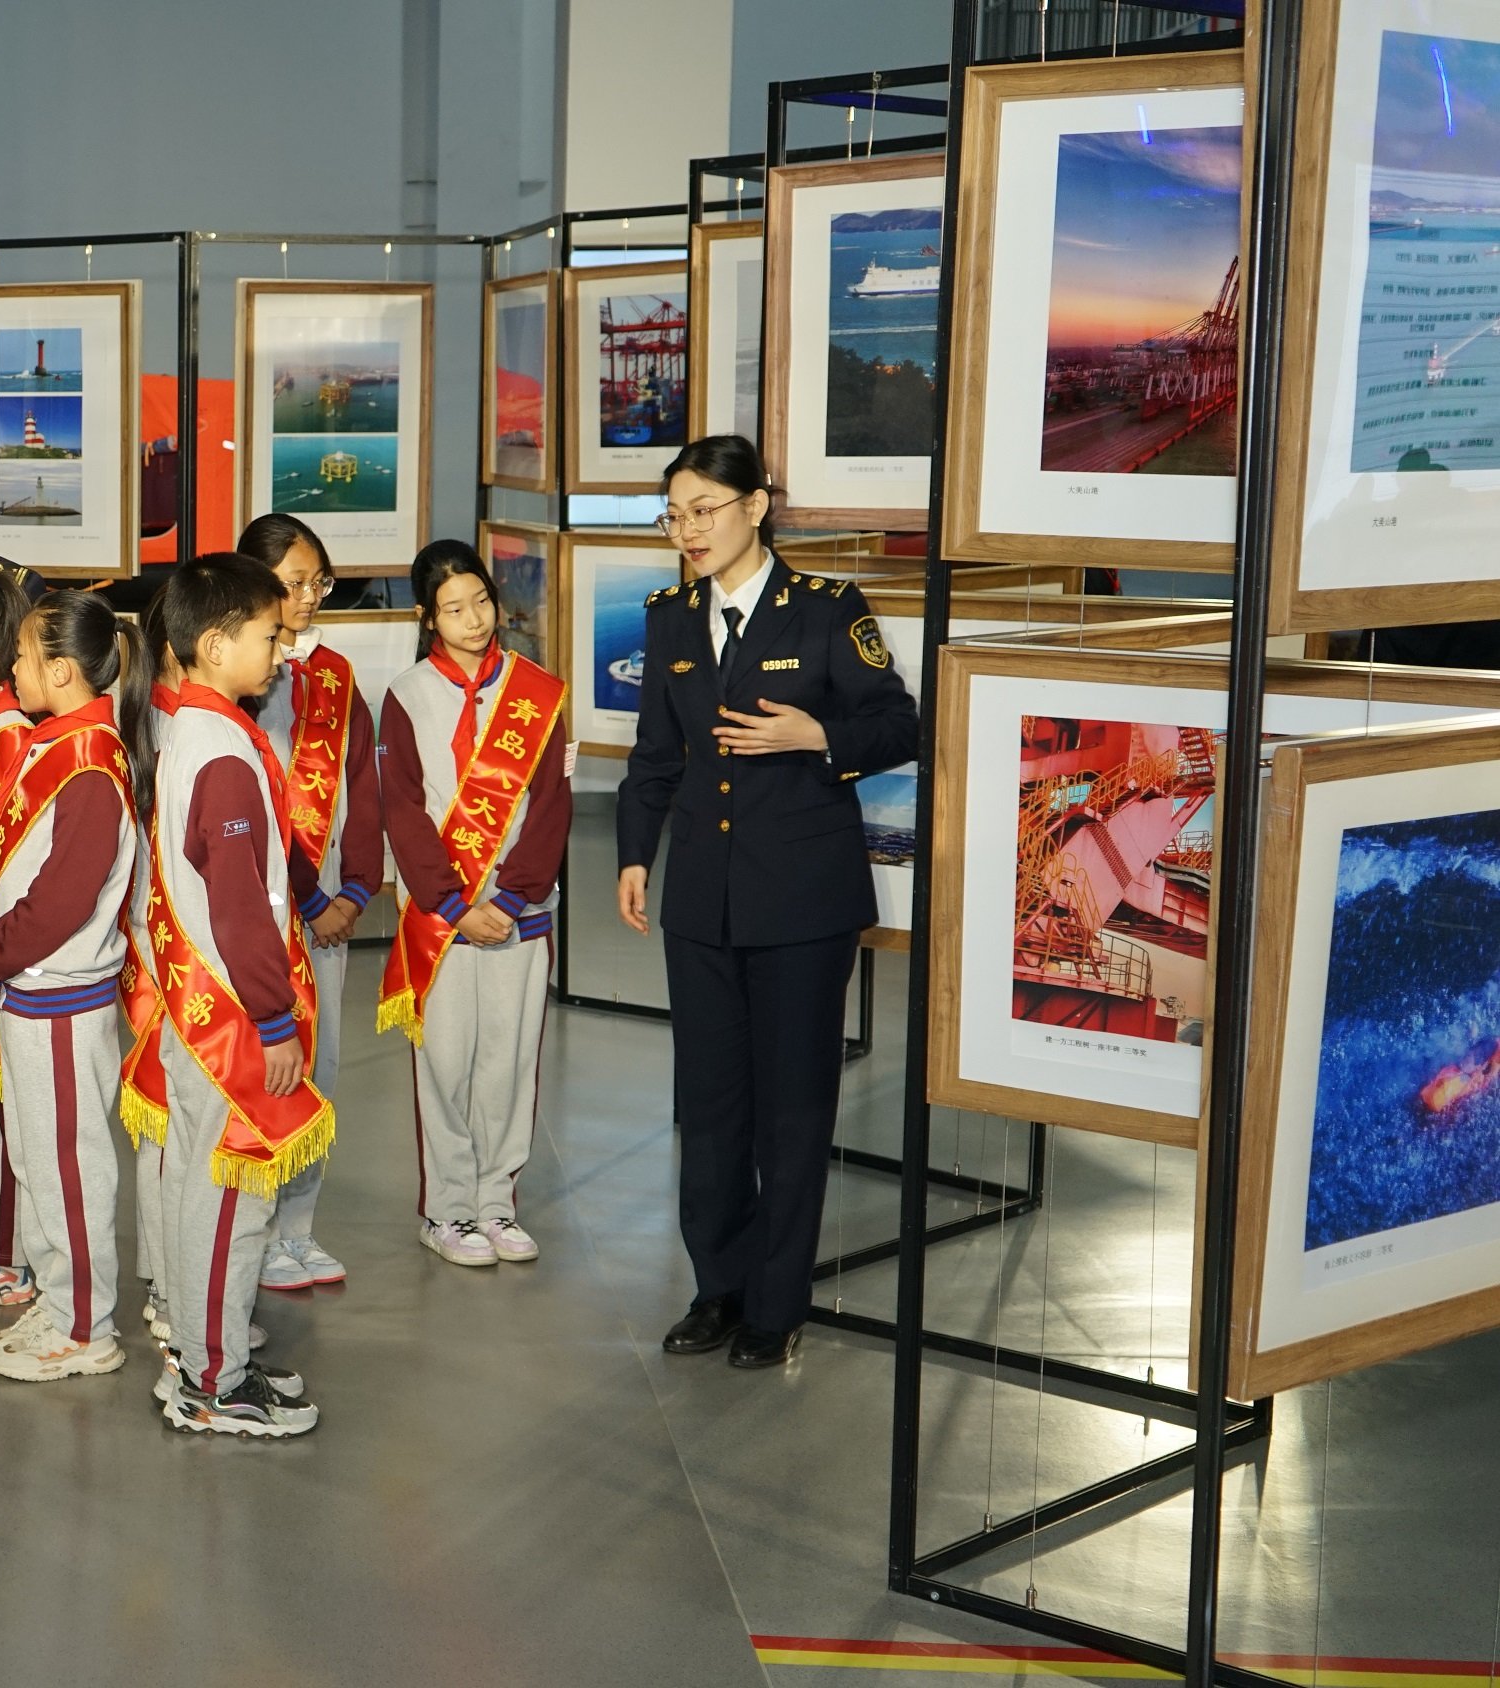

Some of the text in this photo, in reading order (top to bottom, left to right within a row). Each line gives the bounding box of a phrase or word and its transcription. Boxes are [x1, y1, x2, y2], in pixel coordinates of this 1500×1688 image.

[762, 658, 800, 671] 059072
[1046, 1036, 1148, 1057] 建一方工程树一座丰碑 三等奖
